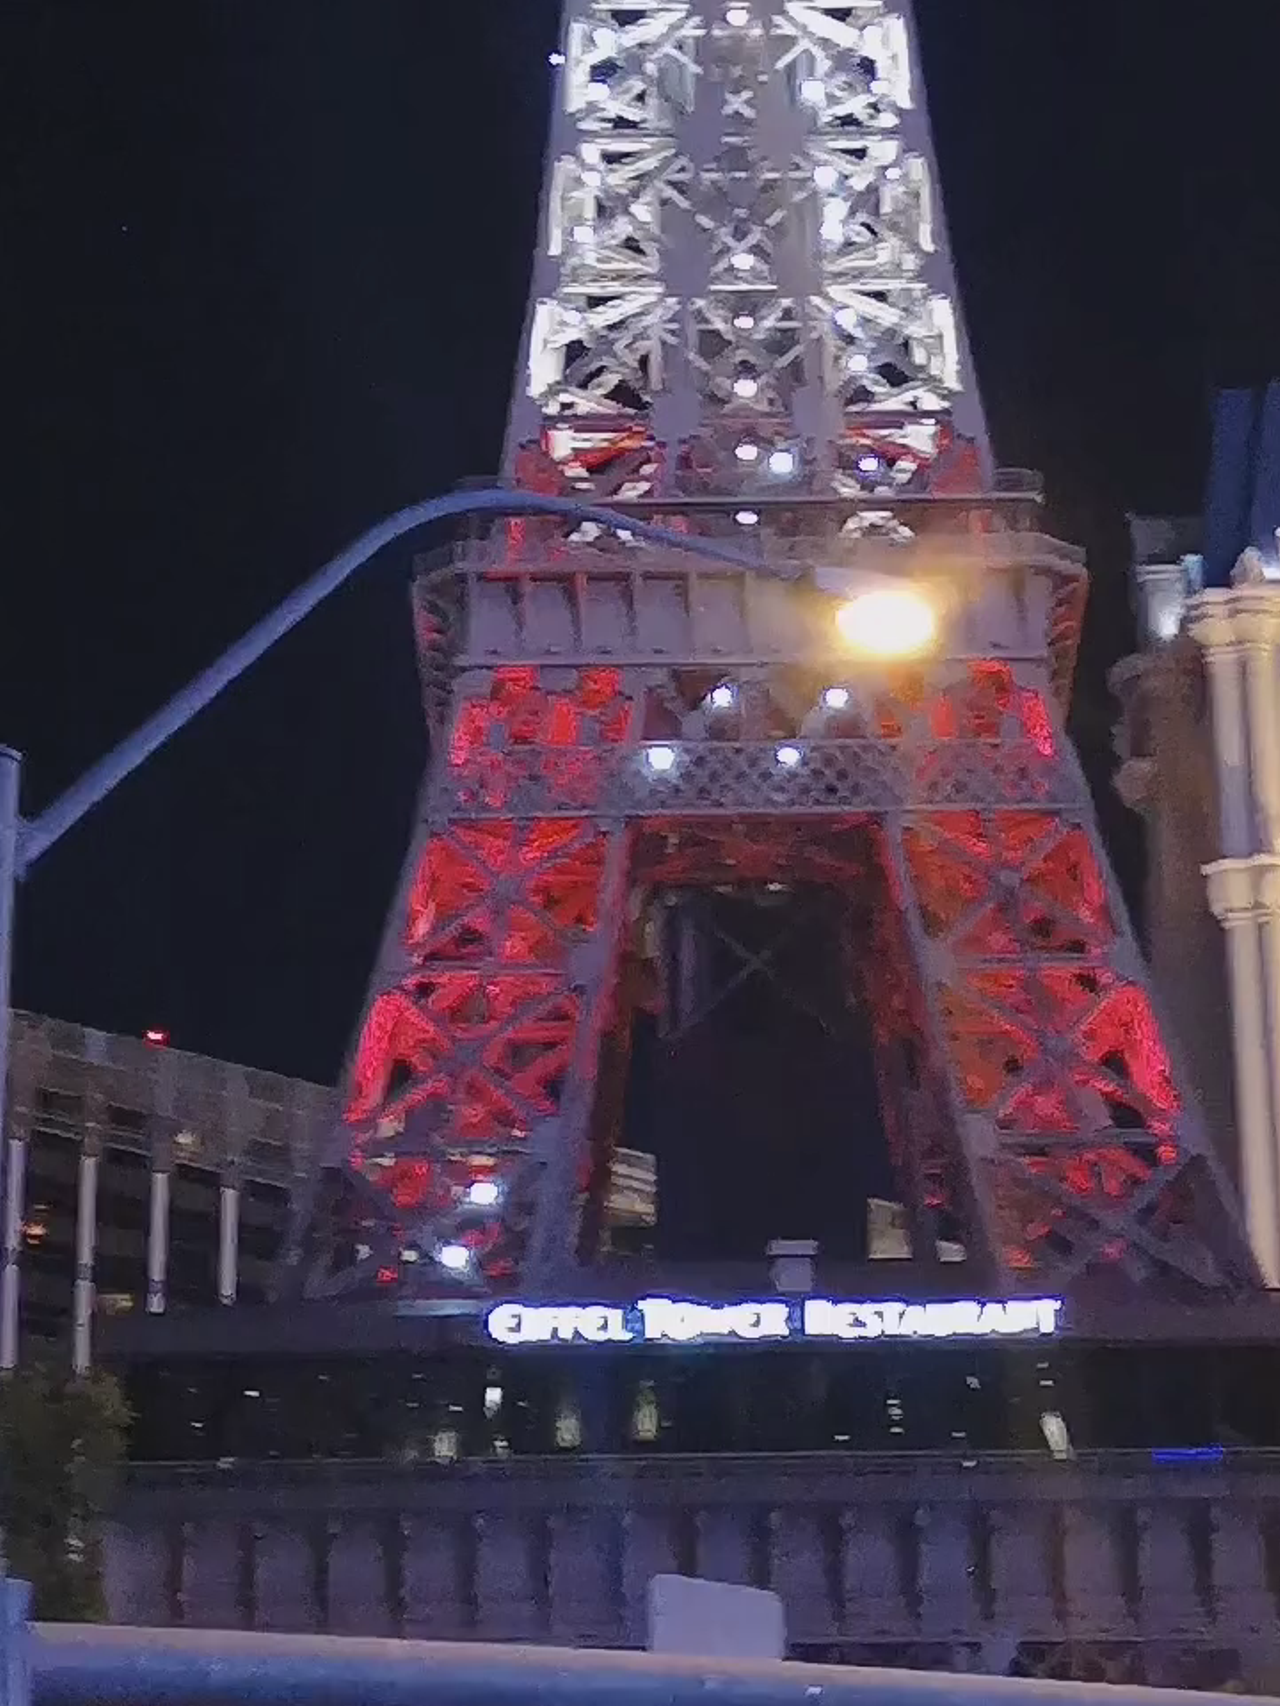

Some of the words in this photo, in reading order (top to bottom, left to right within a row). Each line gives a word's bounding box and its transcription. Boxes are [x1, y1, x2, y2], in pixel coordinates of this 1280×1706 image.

[487, 1303, 633, 1343] EIFFEL
[636, 1297, 790, 1341] TOWER
[803, 1297, 1061, 1338] RESTAURANT
